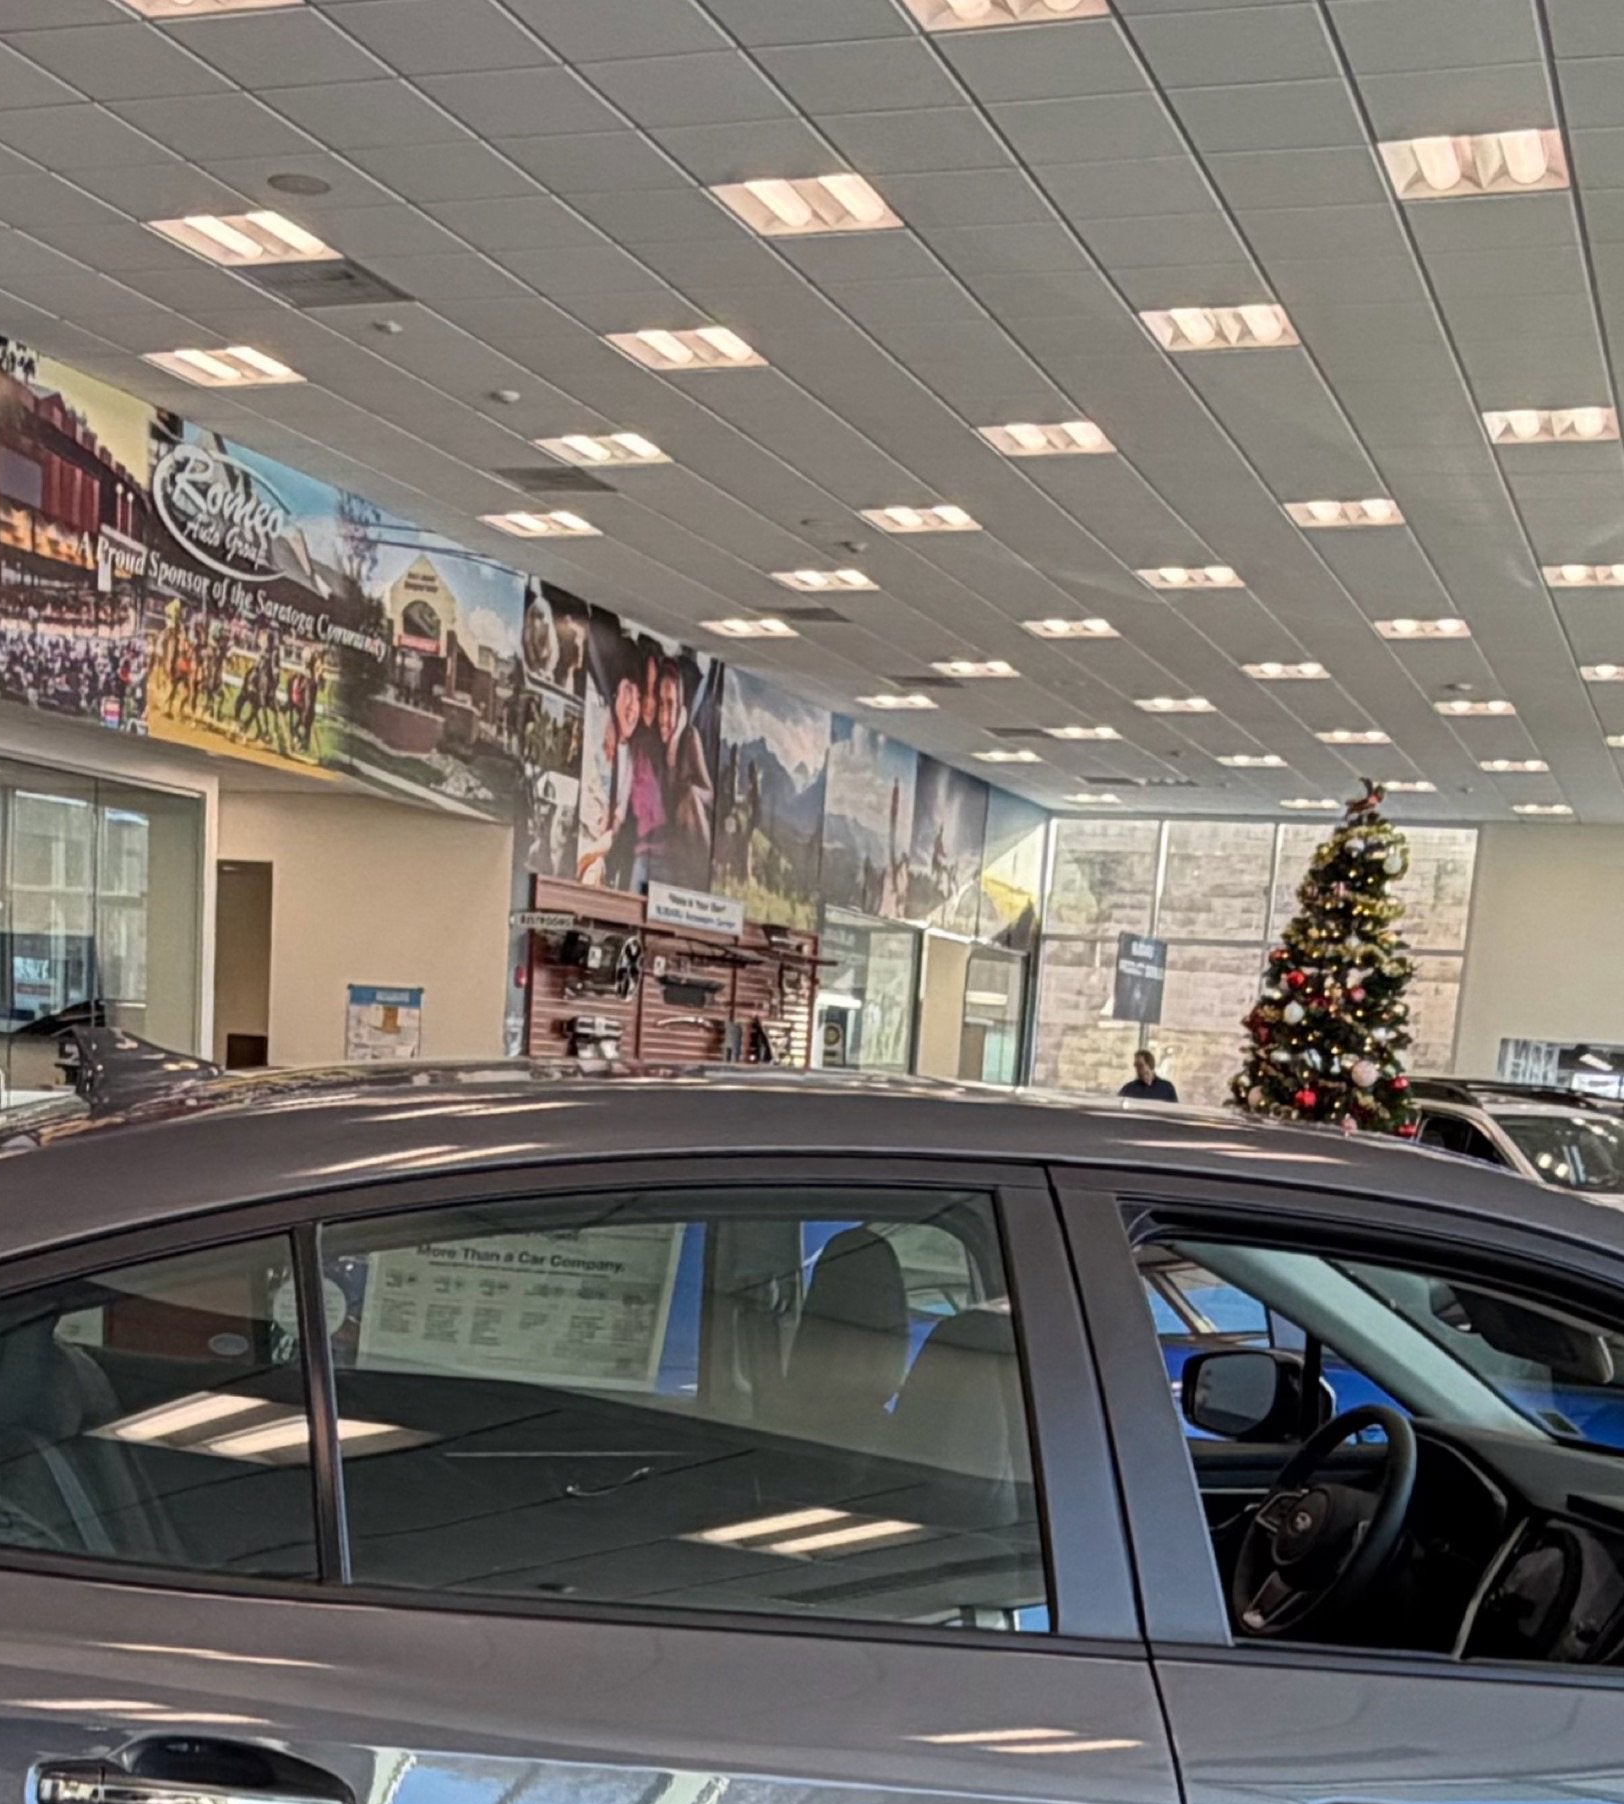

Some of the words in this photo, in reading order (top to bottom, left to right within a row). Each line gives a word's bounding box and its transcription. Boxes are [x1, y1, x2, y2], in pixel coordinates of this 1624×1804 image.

[173, 452, 284, 540] Romeo
[77, 531, 96, 570] A
[97, 535, 145, 576] Proud
[148, 550, 210, 596] Sponsor
[212, 578, 230, 607] of
[231, 580, 254, 612] the
[256, 589, 314, 636] Saratoga
[417, 1244, 457, 1259] More
[461, 1246, 500, 1261] Than
[503, 1252, 514, 1263] a
[518, 1251, 544, 1265] Car
[550, 1255, 626, 1275] Company.
